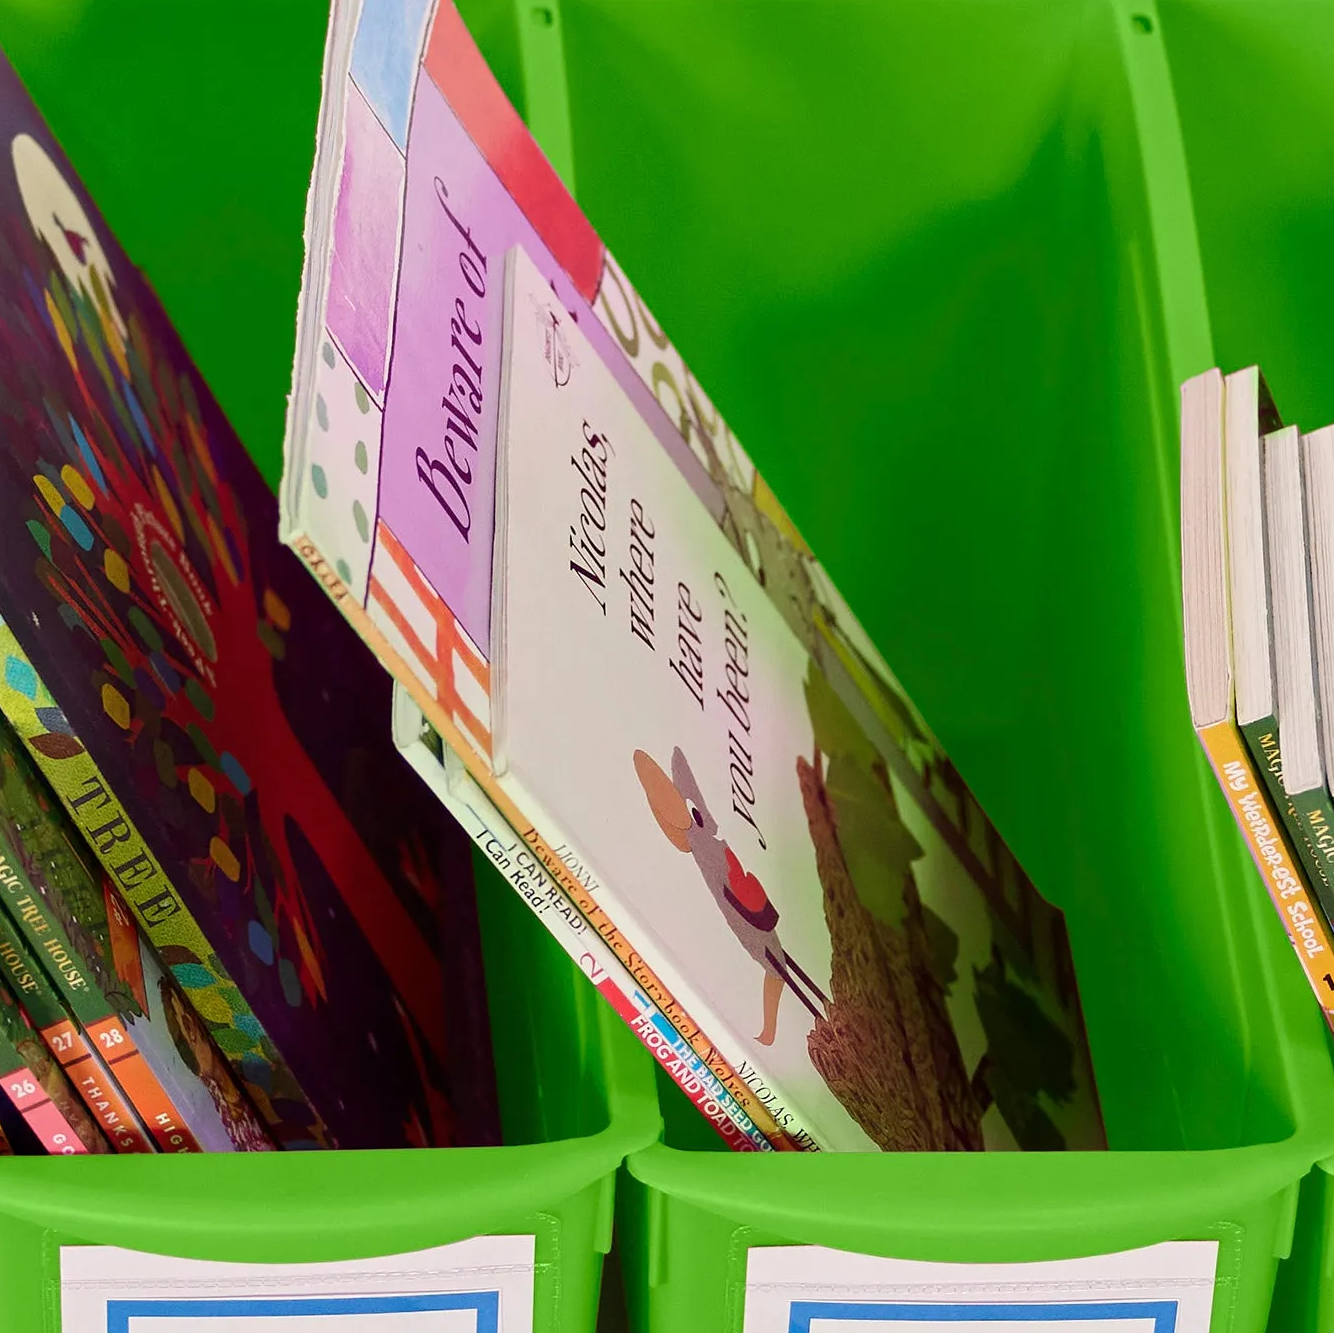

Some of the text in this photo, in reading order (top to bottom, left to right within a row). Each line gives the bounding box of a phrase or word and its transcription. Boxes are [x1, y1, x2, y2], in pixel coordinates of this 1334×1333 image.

[416, 176, 487, 545] Beware of
[569, 419, 616, 616] Nicolas,
[620, 498, 656, 652] where
[669, 581, 705, 711] have
[715, 571, 767, 851] you been?
[1223, 760, 1249, 792] My
[66, 776, 182, 928] TREE
[476, 829, 550, 914] I Can Read!
[508, 843, 589, 936] I CAN READ!
[554, 844, 600, 894] LIONNI
[16, 894, 52, 937] TREE
[523, 827, 751, 1108] Beware of the Storybook Wolves
[579, 952, 604, 979] 2
[633, 989, 652, 1010] 1
[52, 1031, 73, 1052] 27
[99, 1028, 124, 1049] 28
[630, 1014, 670, 1060] FROG
[665, 1058, 701, 1094] AND
[696, 1091, 736, 1137] TOAD
[11, 1079, 36, 1099] 26
[80, 1075, 134, 1147] THANKS
[673, 1039, 700, 1069] THE
[694, 1065, 724, 1097] BAD
[719, 1094, 754, 1133] SEED
